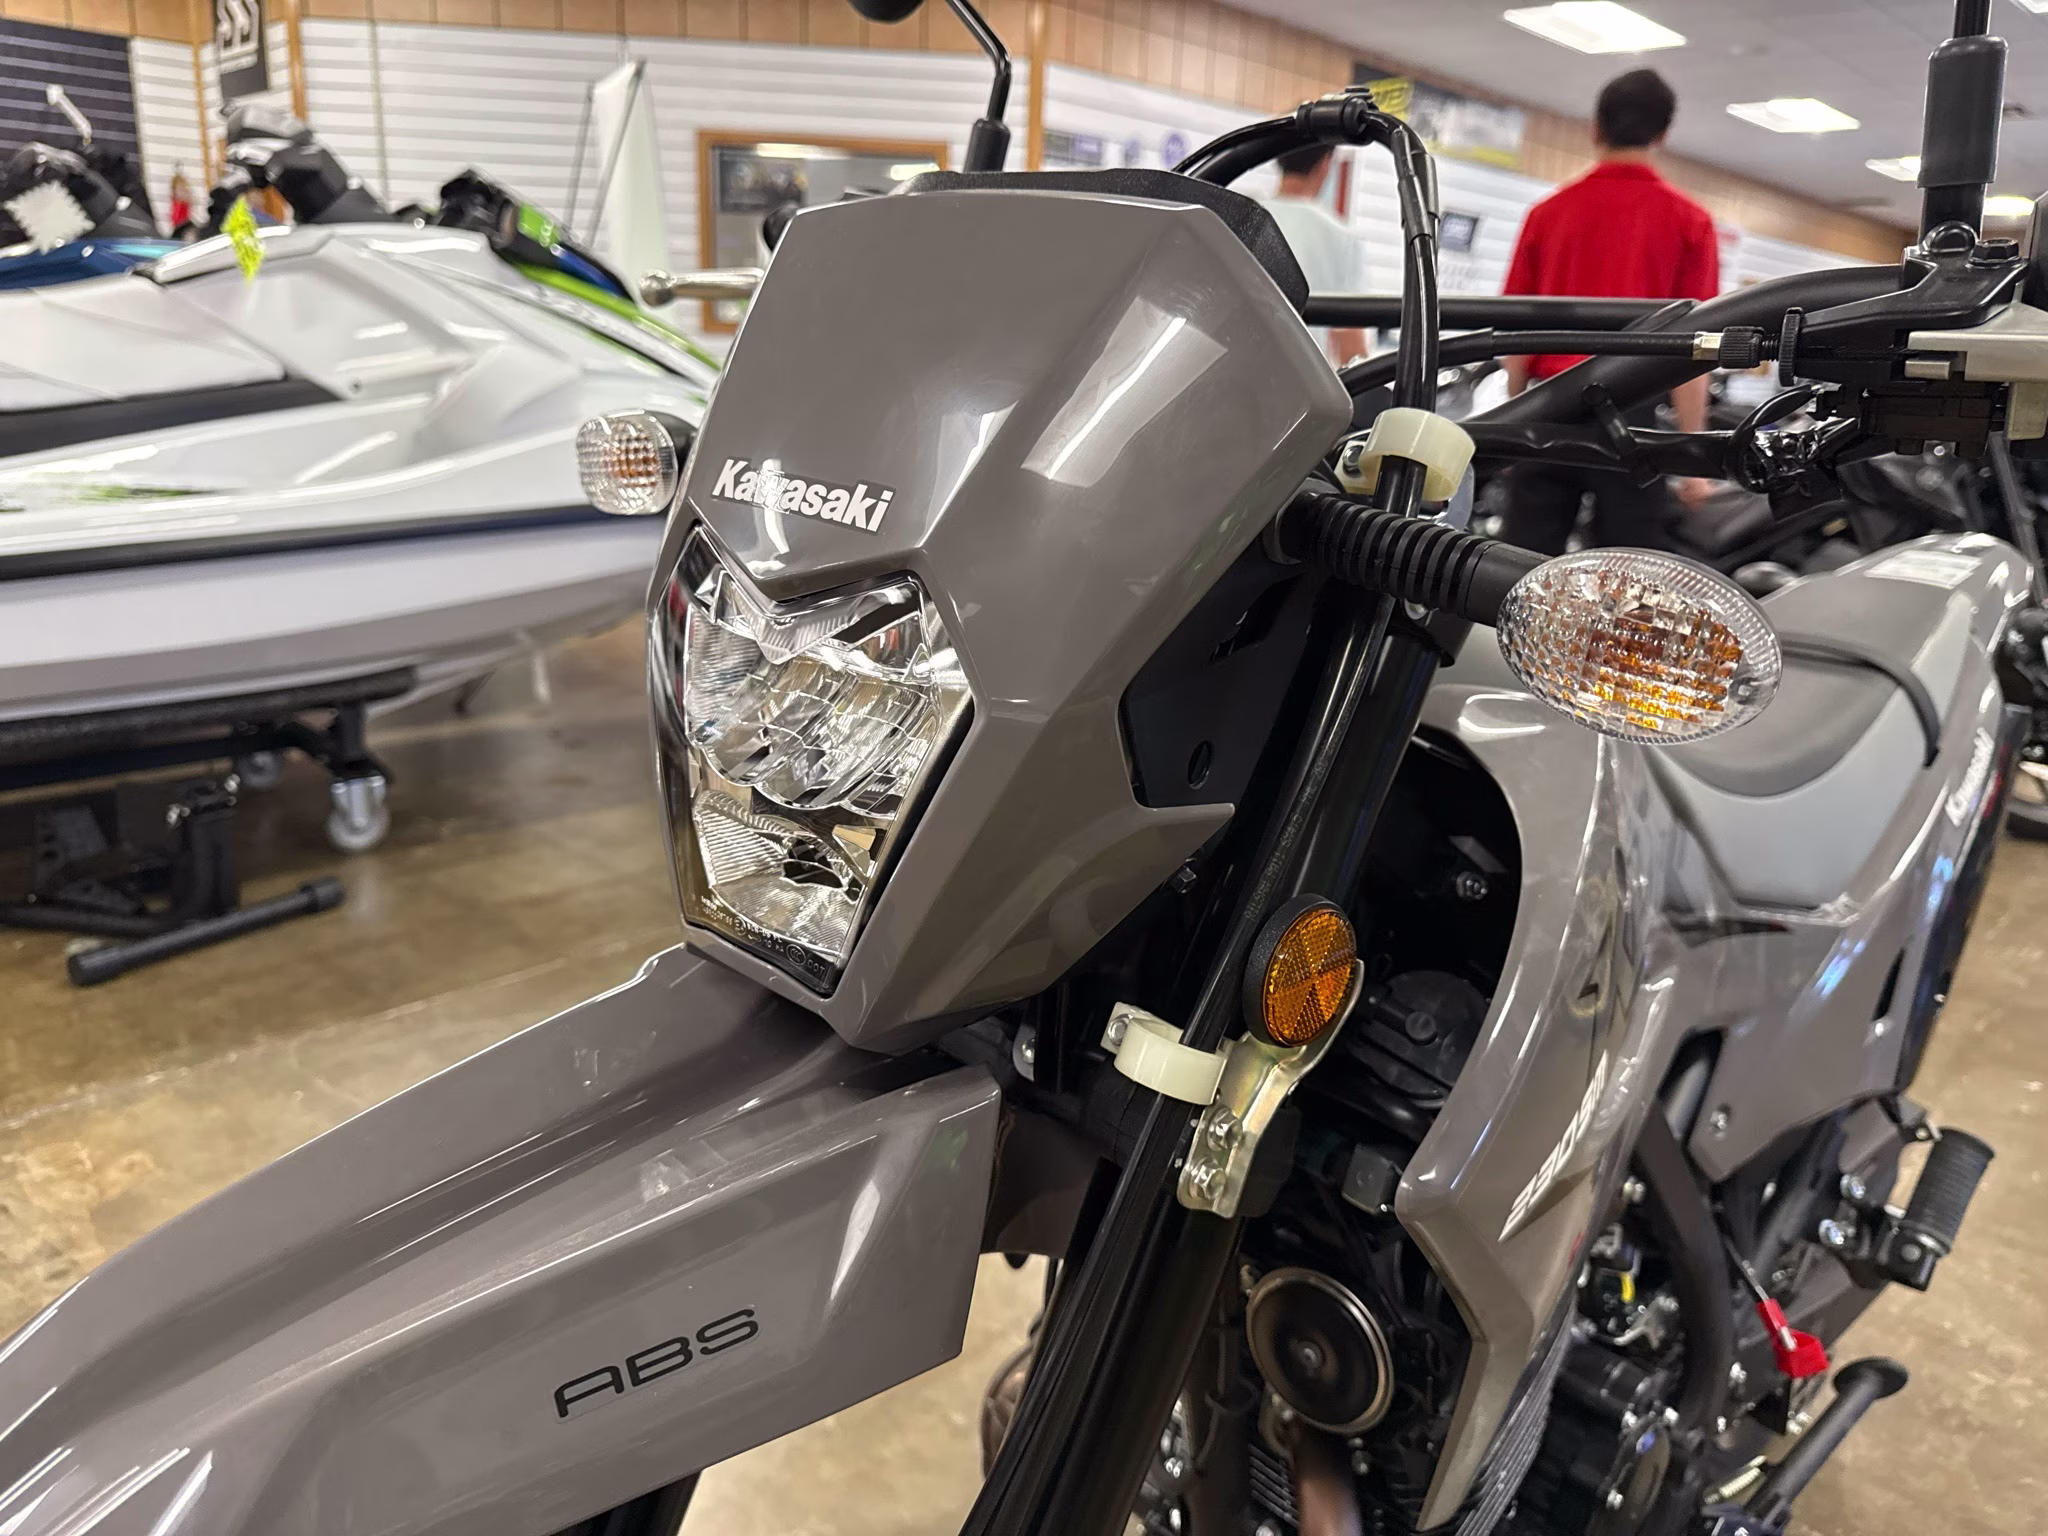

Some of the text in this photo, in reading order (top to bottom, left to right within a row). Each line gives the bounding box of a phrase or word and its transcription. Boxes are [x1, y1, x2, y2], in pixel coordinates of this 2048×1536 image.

[712, 459, 894, 532] Kawasaki
[1497, 1049, 1608, 1243] 230SM
[554, 1308, 759, 1418] ABS
